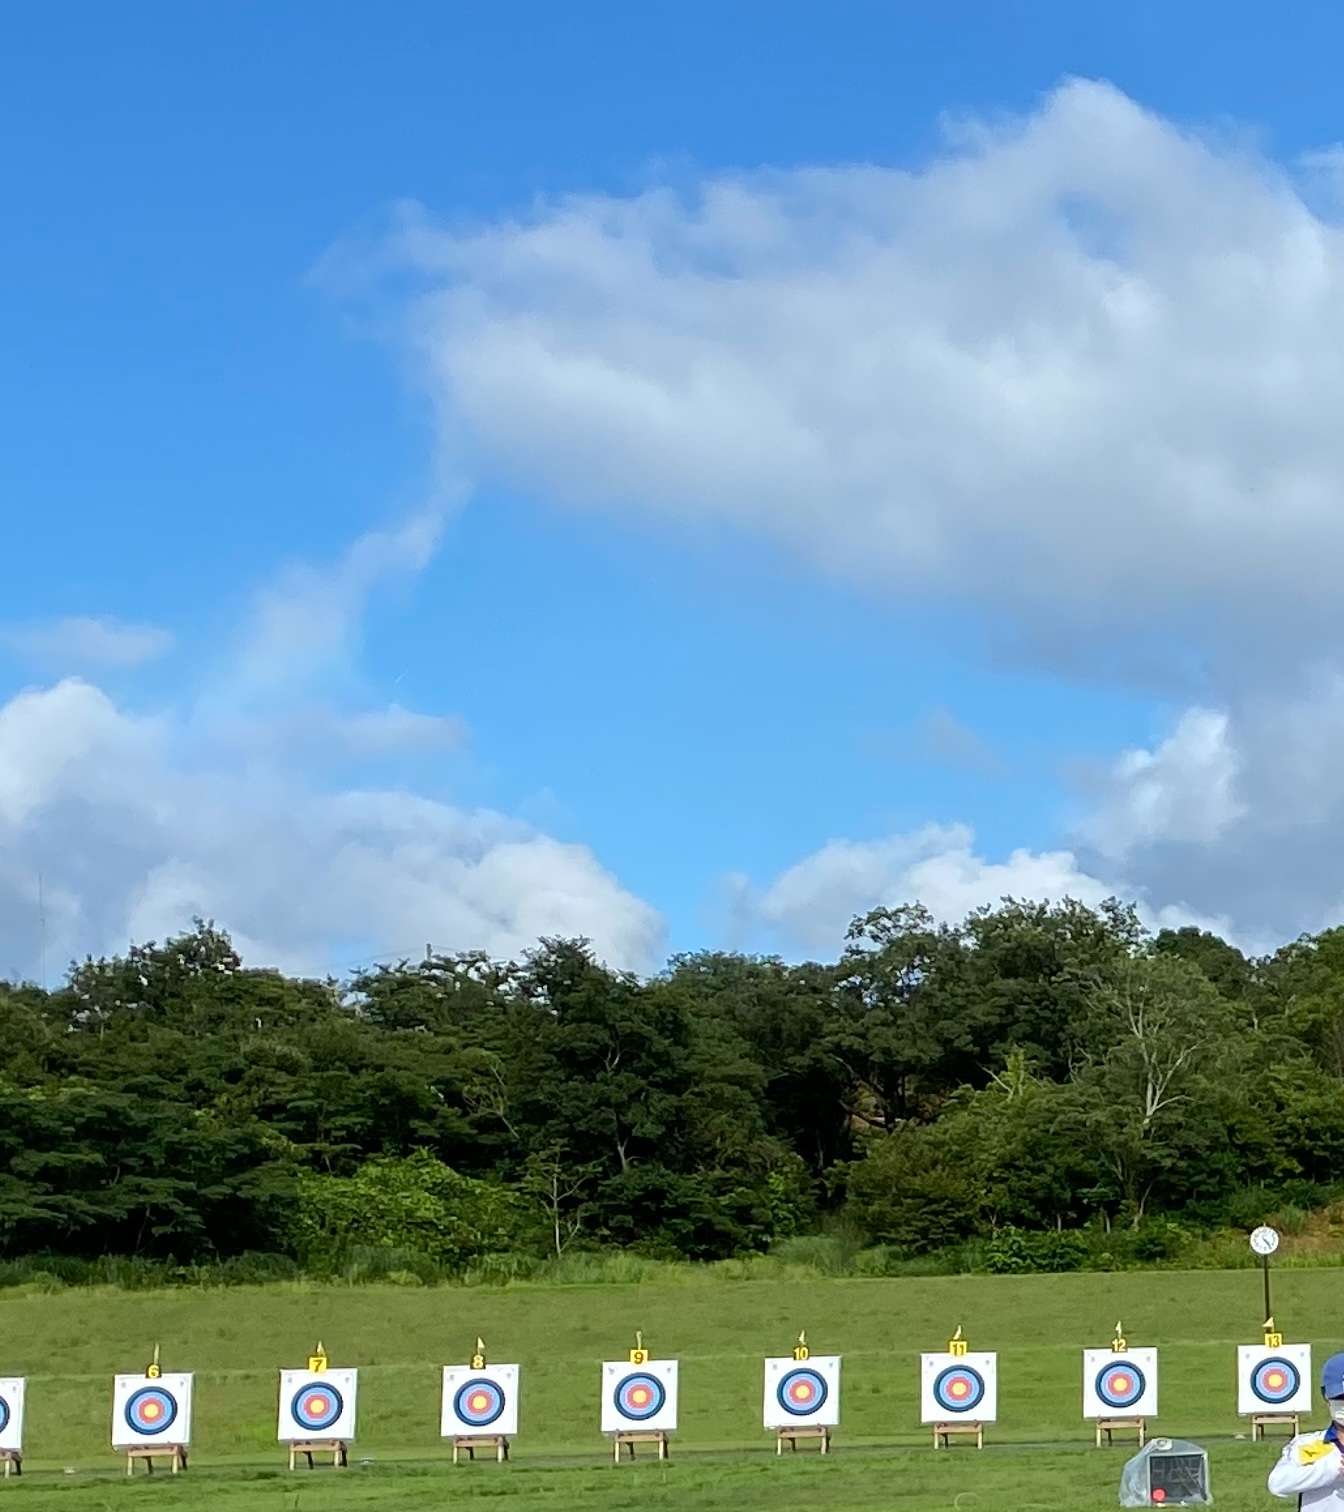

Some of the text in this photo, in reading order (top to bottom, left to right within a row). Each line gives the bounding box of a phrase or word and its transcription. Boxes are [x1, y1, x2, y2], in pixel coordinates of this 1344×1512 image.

[1111, 1338, 1126, 1352] 12
[1269, 1335, 1281, 1348] 13
[793, 1346, 809, 1360] 10
[953, 1343, 964, 1357] 11
[473, 1354, 484, 1368] 8
[633, 1351, 644, 1364] 9
[148, 1364, 160, 1378] 6
[312, 1359, 323, 1373] 7
